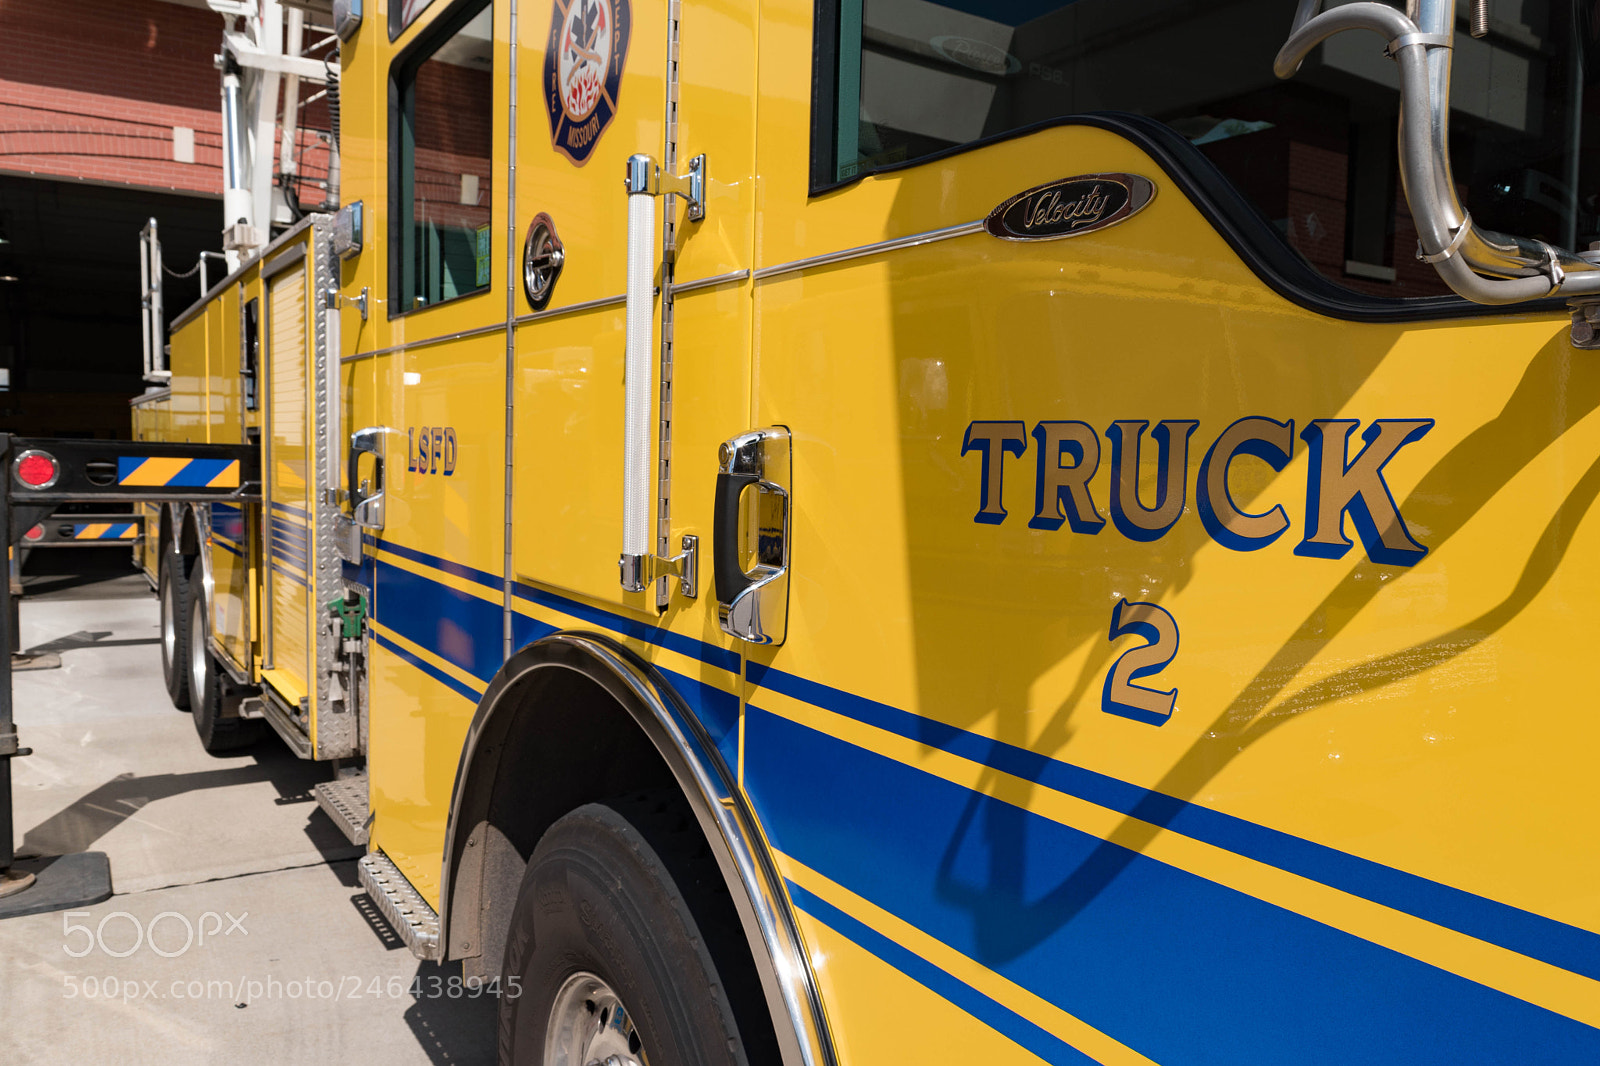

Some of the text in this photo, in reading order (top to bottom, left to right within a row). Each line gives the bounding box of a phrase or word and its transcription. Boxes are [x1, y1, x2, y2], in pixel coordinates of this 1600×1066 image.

[613, 0, 622, 75] EPT
[568, 113, 600, 148] MISSOURI
[1023, 184, 1110, 229] Velocity
[408, 426, 457, 476] LSFD
[961, 416, 1435, 567] TRUCK
[1102, 598, 1180, 727] 2
